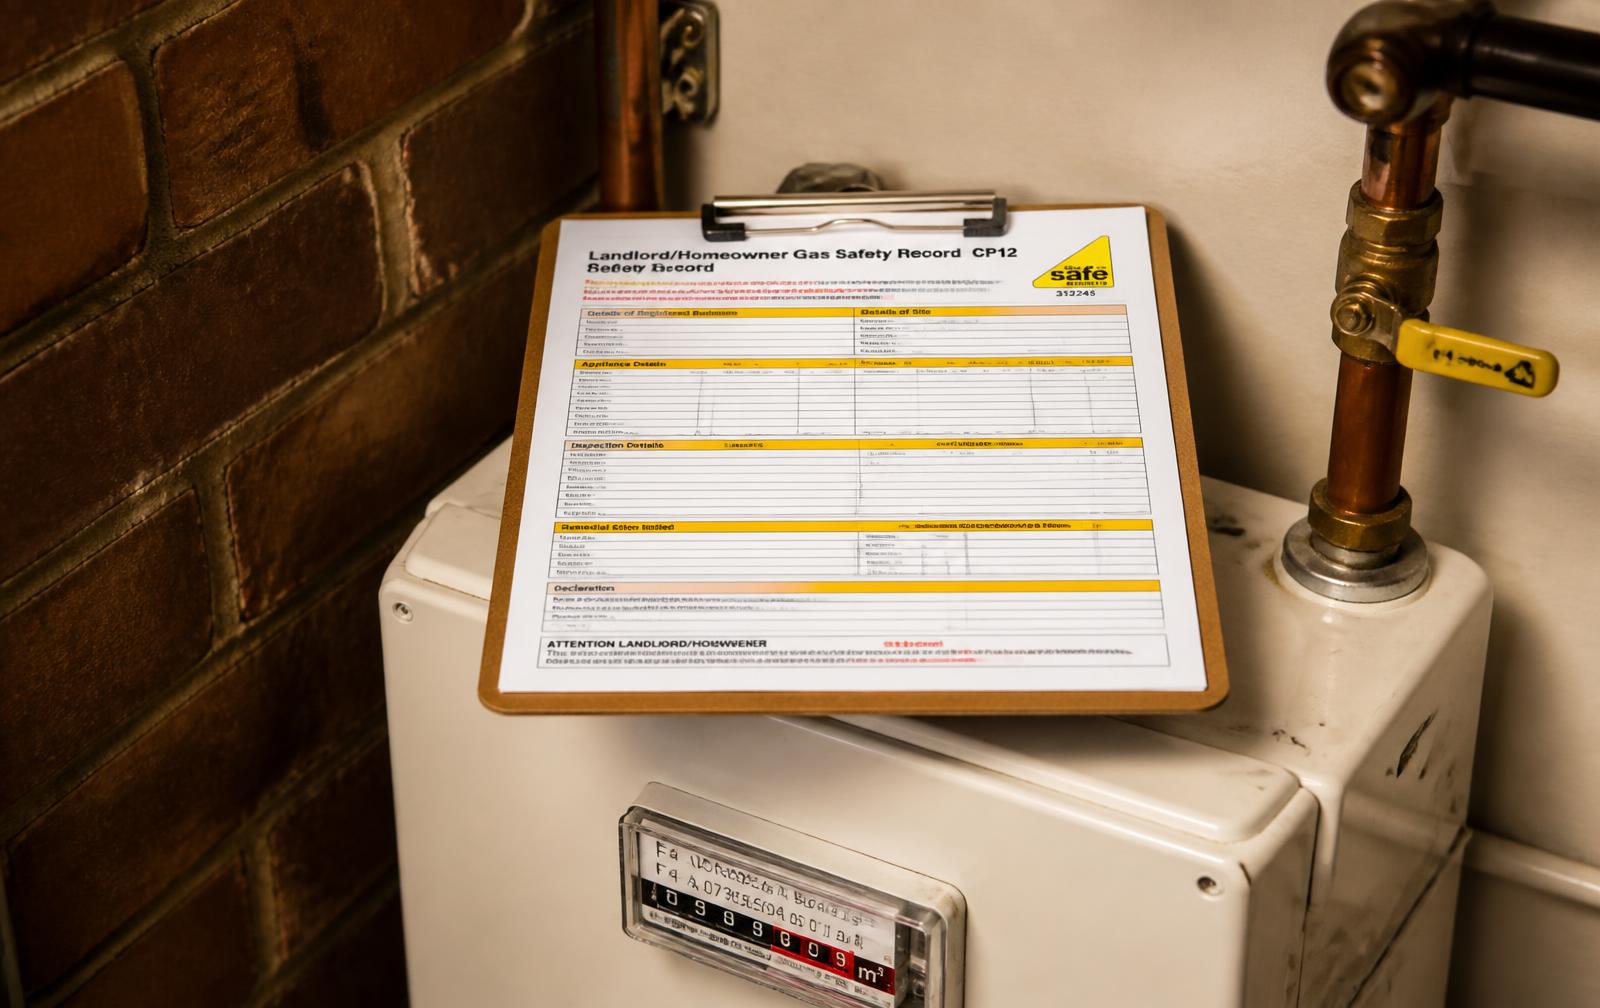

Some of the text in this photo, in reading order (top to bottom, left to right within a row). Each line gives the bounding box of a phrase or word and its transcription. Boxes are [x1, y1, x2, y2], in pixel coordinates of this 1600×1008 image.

[588, 247, 1018, 261] Landlord/Homeowner Gas Safety Record CP12
[1050, 265, 1108, 281] safe
[547, 640, 616, 648] ATTENTION
